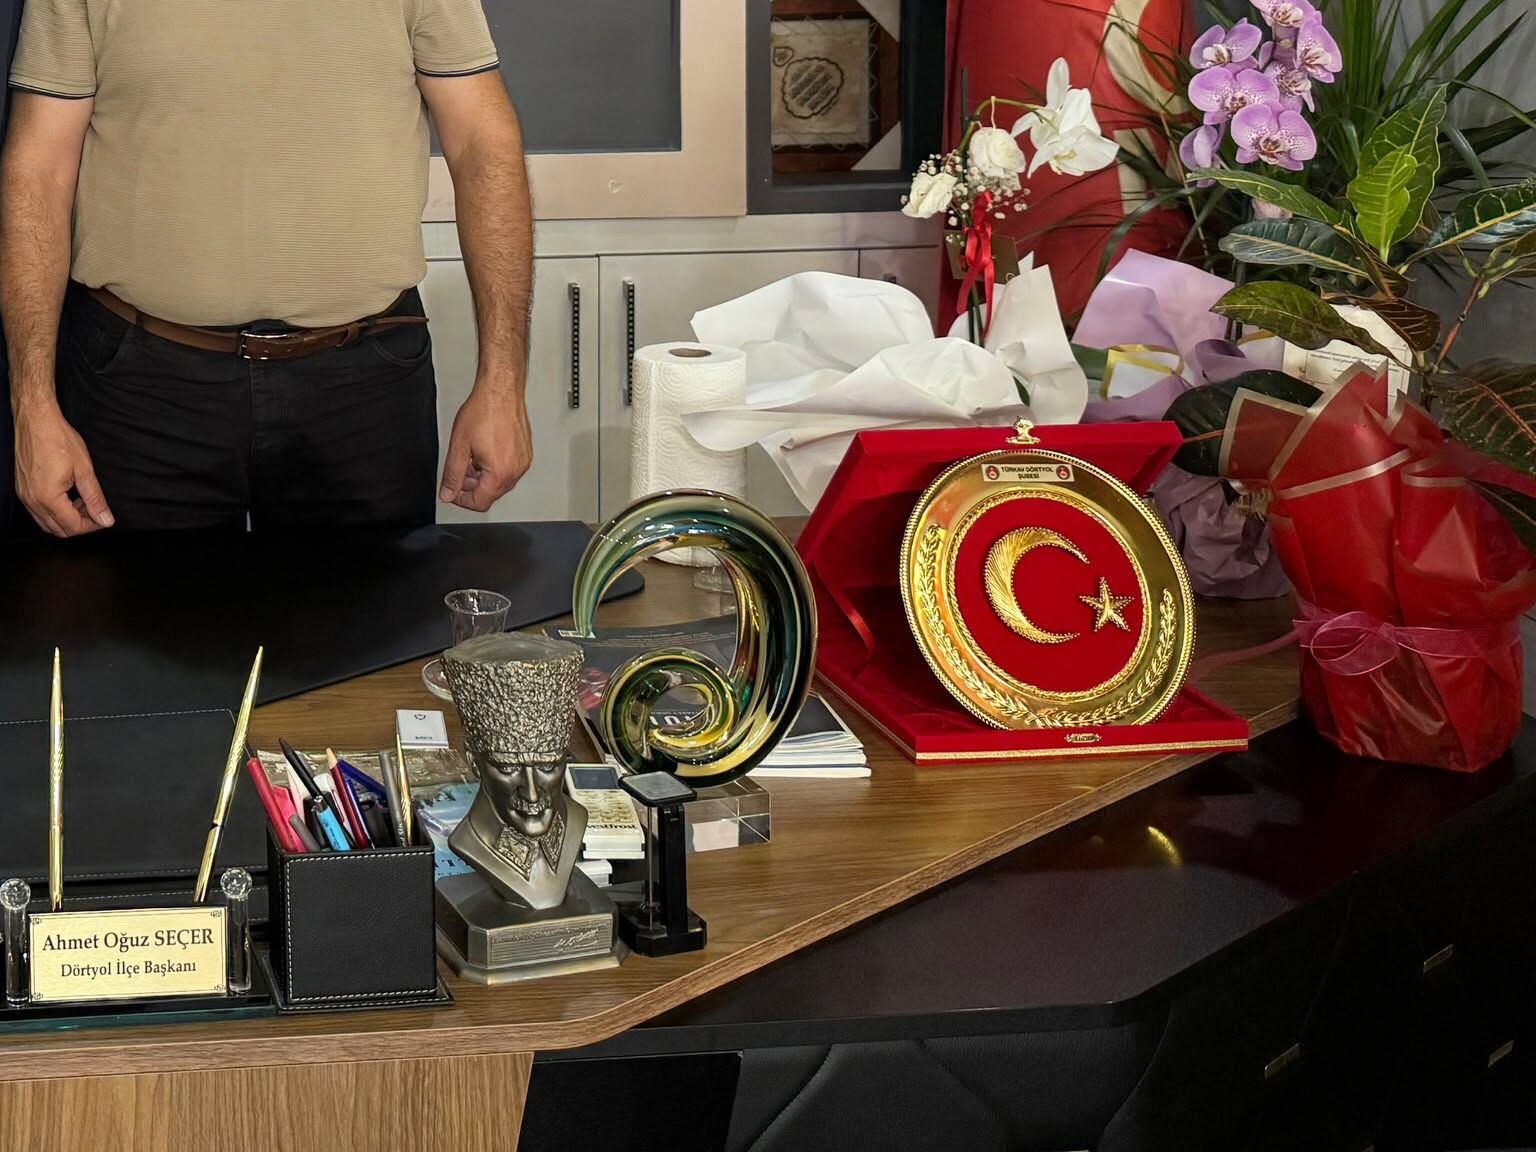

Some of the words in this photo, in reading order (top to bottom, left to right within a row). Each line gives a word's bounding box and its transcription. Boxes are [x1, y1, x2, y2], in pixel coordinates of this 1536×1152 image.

[42, 933, 99, 951] Ahmet
[104, 931, 150, 953] Oğuz
[154, 928, 214, 949] SEÇER
[61, 962, 112, 980] Dörtyol
[116, 958, 140, 978] İlçe
[144, 959, 196, 976] Başkanı
